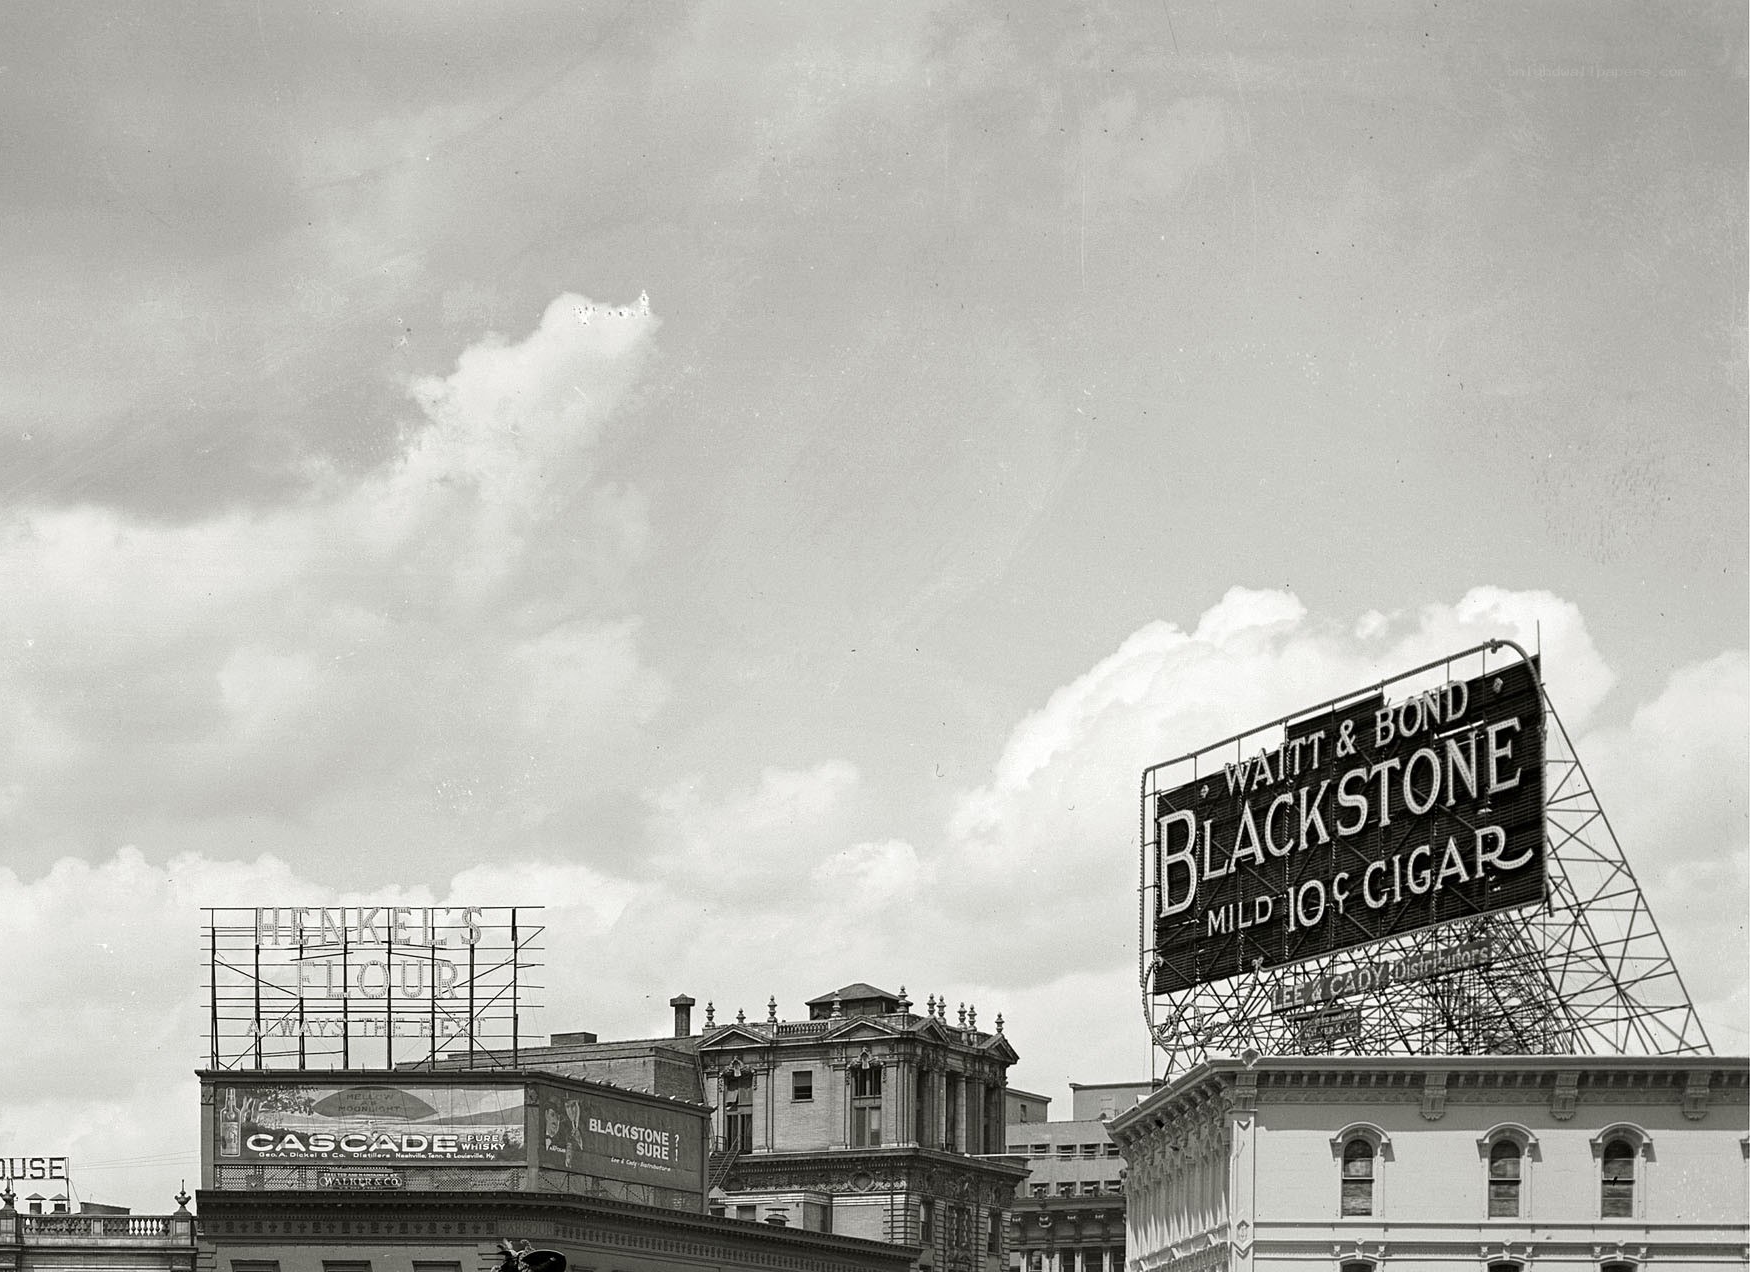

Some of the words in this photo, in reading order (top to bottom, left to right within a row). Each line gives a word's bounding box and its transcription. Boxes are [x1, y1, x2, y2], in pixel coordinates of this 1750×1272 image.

[1223, 730, 1324, 797] WAITT
[1335, 719, 1356, 756] &
[1375, 678, 1469, 749] BOND
[1158, 716, 1522, 918] BLACKSTONE
[1206, 894, 1272, 938] MILD
[1363, 824, 1535, 910] CIGAR
[256, 906, 483, 946] HENKEL'S
[296, 958, 459, 1000] FLOUR
[1270, 984, 1304, 1010] LEE
[1329, 964, 1386, 997] CADY
[246, 1134, 459, 1153] CASCADE
[461, 1143, 506, 1151] WHISKY
[589, 1118, 669, 1146] BLACKSTONE
[636, 1142, 669, 1160] SURE
[324, 1176, 373, 1187] WALKER
[373, 1177, 382, 1187] &
